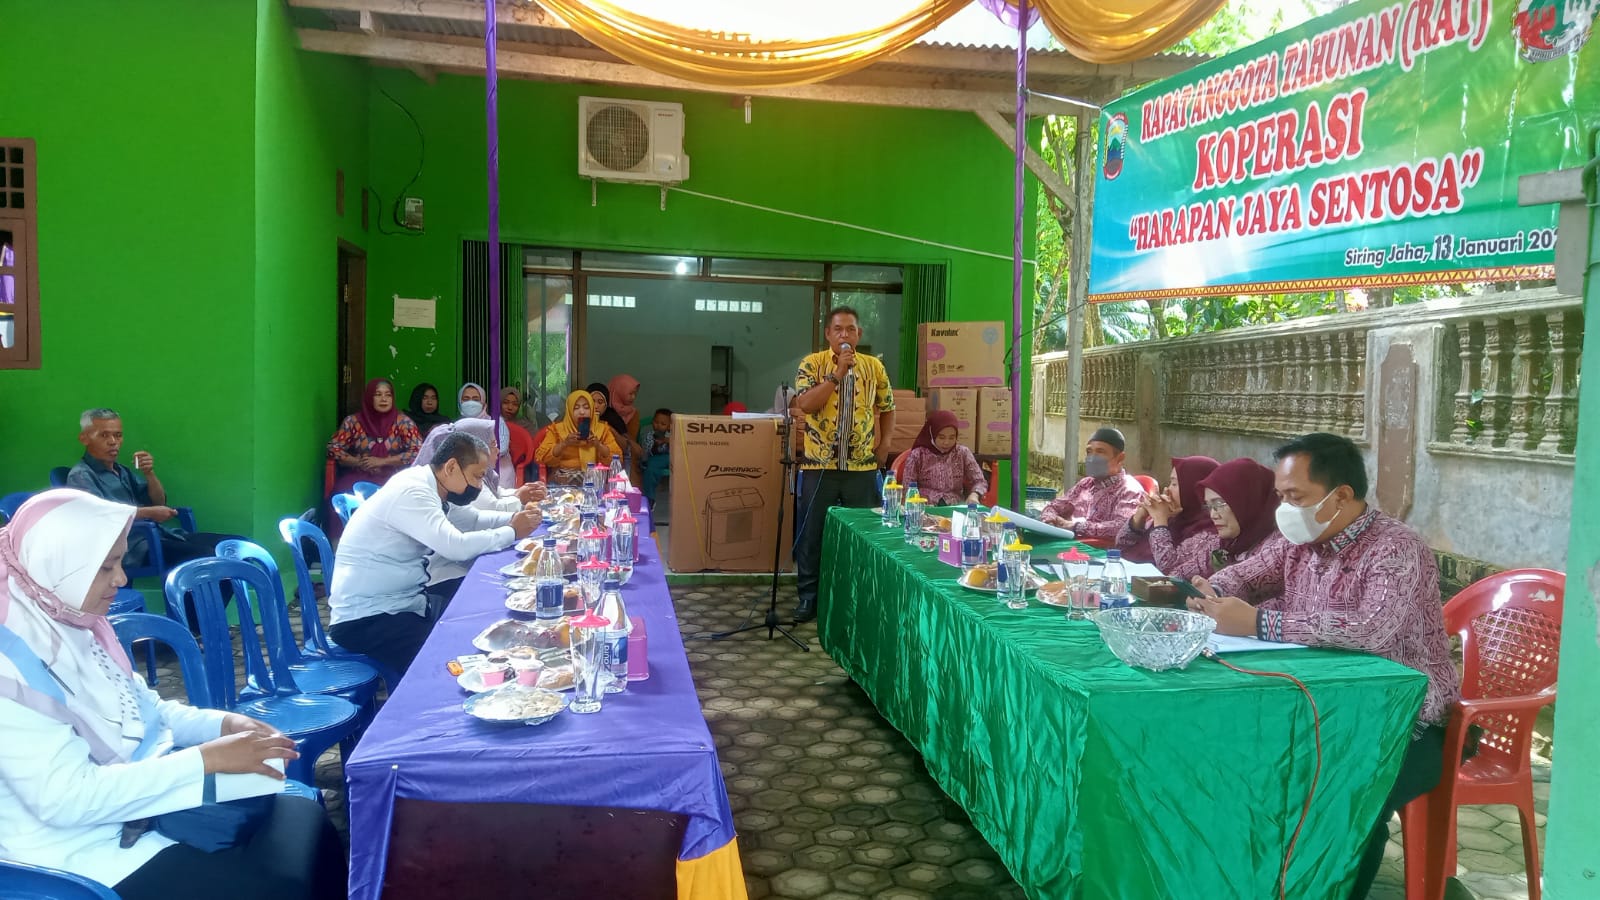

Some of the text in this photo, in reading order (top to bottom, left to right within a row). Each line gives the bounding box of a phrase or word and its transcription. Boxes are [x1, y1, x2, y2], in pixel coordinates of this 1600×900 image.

[1141, 0, 1490, 142] RAPAT ANGGOTA TAHUNAN (RAT)
[1193, 91, 1367, 190] KOPERASI
[1130, 152, 1482, 251] “HARAPAN JAYA SENTOSA”
[1344, 247, 1385, 267] Siring
[1387, 243, 1430, 262] Jaha,
[1434, 234, 1453, 260] 13
[1456, 231, 1523, 256] Januari
[687, 422, 755, 435] SHARP
